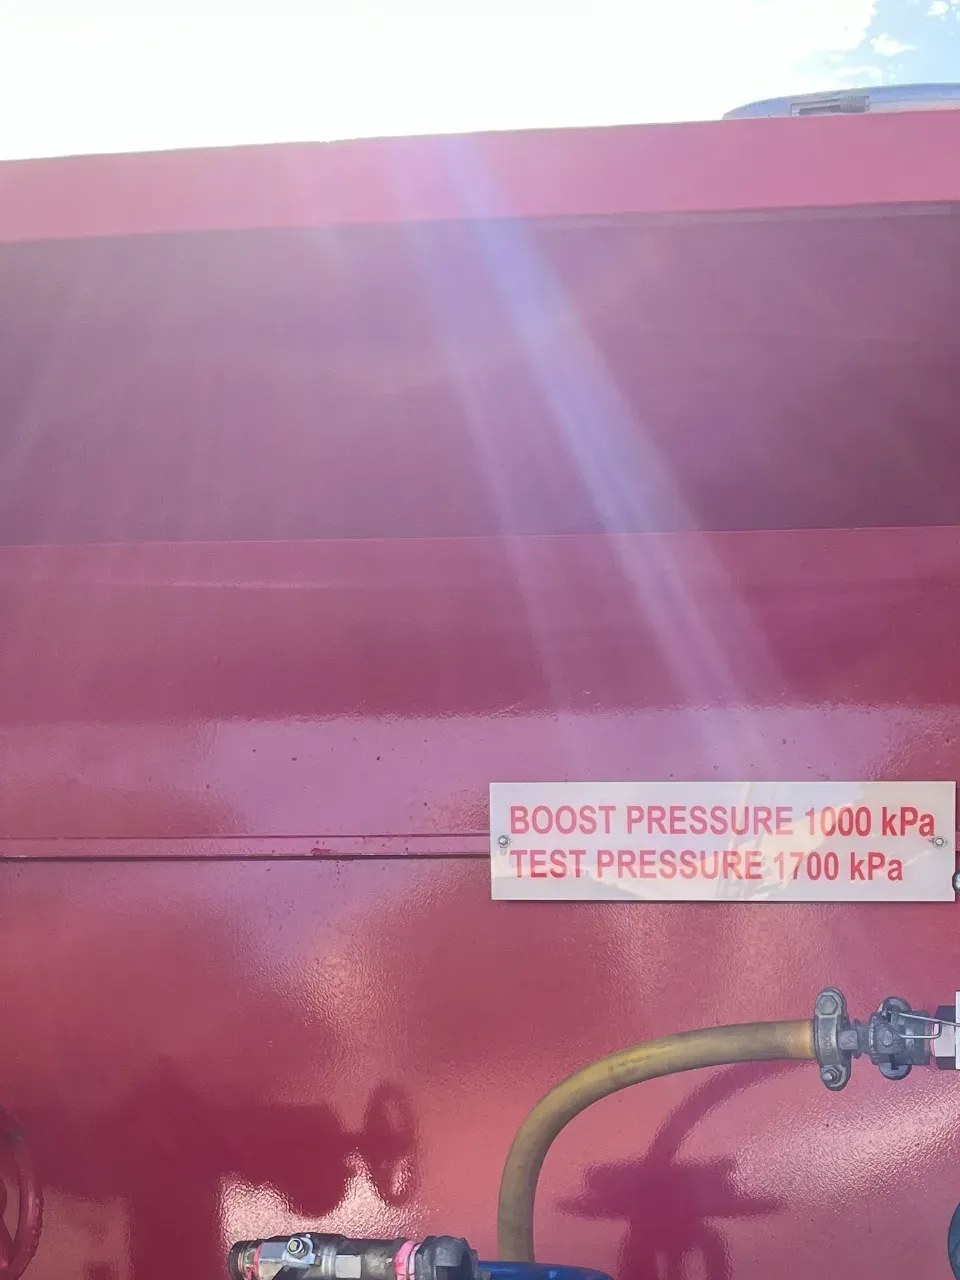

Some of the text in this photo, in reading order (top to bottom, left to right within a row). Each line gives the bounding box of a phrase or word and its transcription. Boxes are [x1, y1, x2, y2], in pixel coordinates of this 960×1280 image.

[510, 805, 936, 837] BOOST PRESSURE 1000 kPa
[509, 849, 903, 881] TEST PRESSURE 1700 kPa
